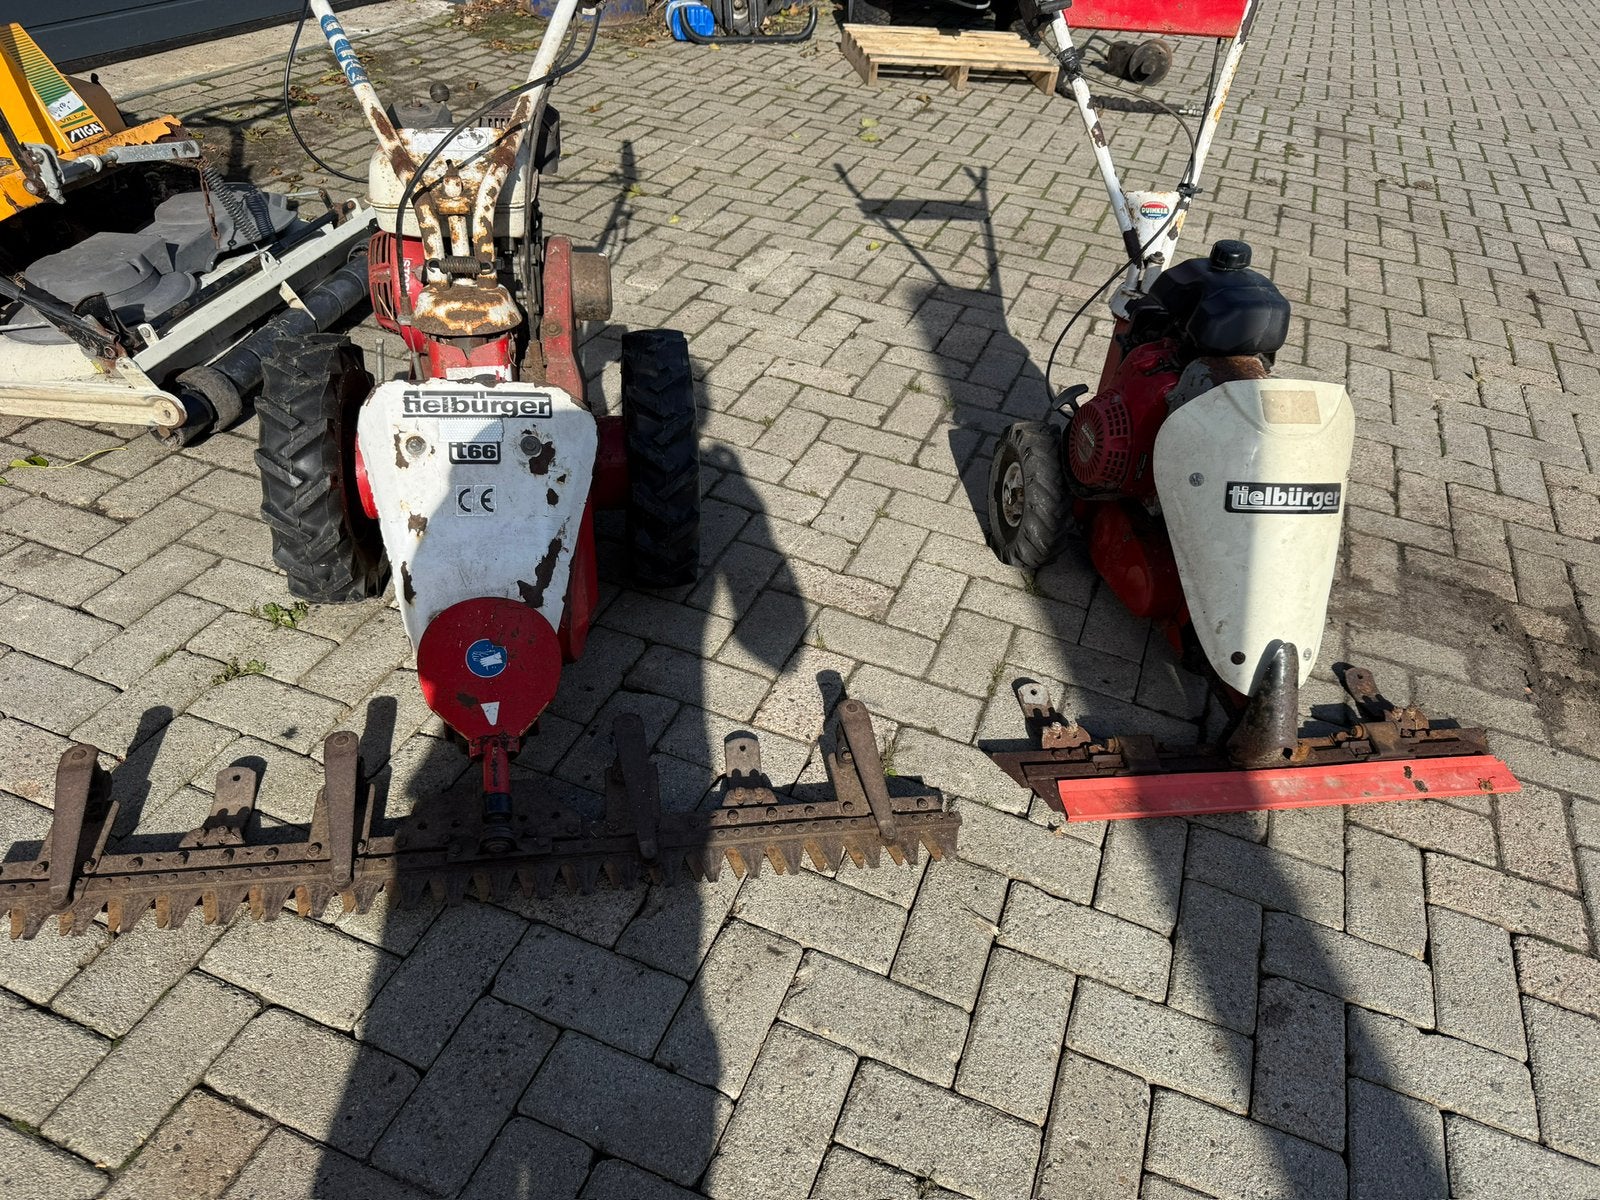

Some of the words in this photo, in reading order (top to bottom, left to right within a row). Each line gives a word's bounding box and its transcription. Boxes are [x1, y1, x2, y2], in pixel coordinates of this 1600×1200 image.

[60, 111, 88, 124] VILLA
[70, 121, 104, 142] STIGA
[402, 391, 552, 417] tielbürger
[454, 442, 498, 459] t66
[458, 488, 494, 513] CE
[1229, 485, 1340, 511] tielbürger
